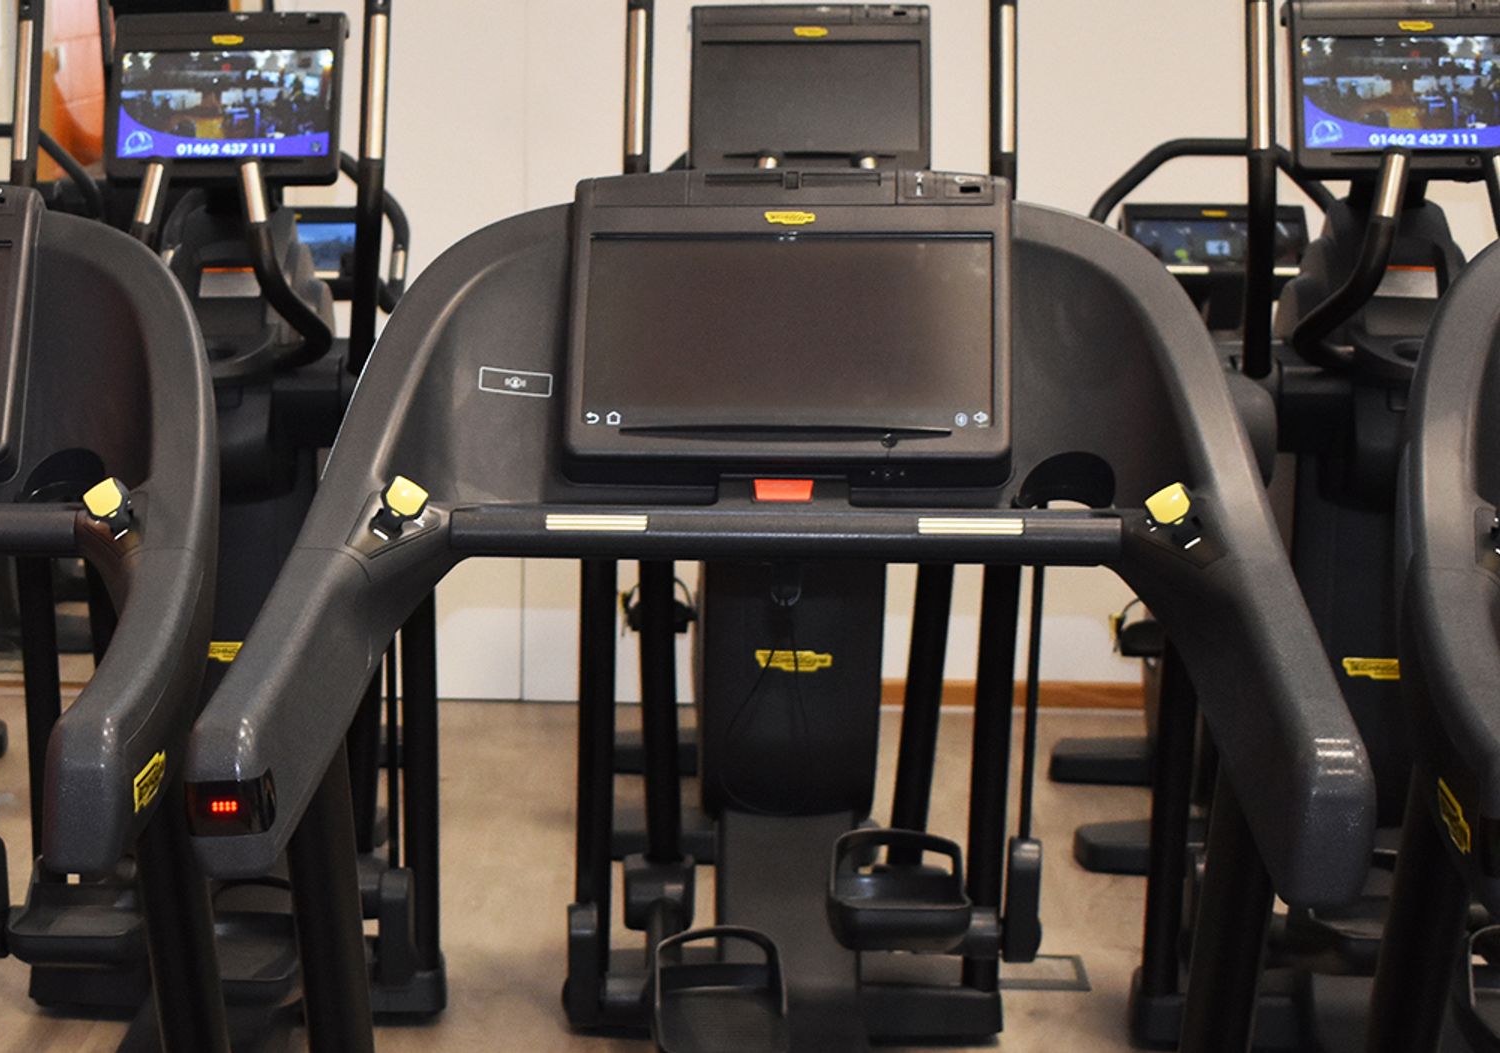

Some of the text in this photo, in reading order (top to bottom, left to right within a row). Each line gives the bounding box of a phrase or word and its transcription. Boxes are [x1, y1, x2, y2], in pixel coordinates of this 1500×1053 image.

[1368, 133, 1477, 146] 01462 437 111
[176, 143, 275, 156] 01462 437 111
